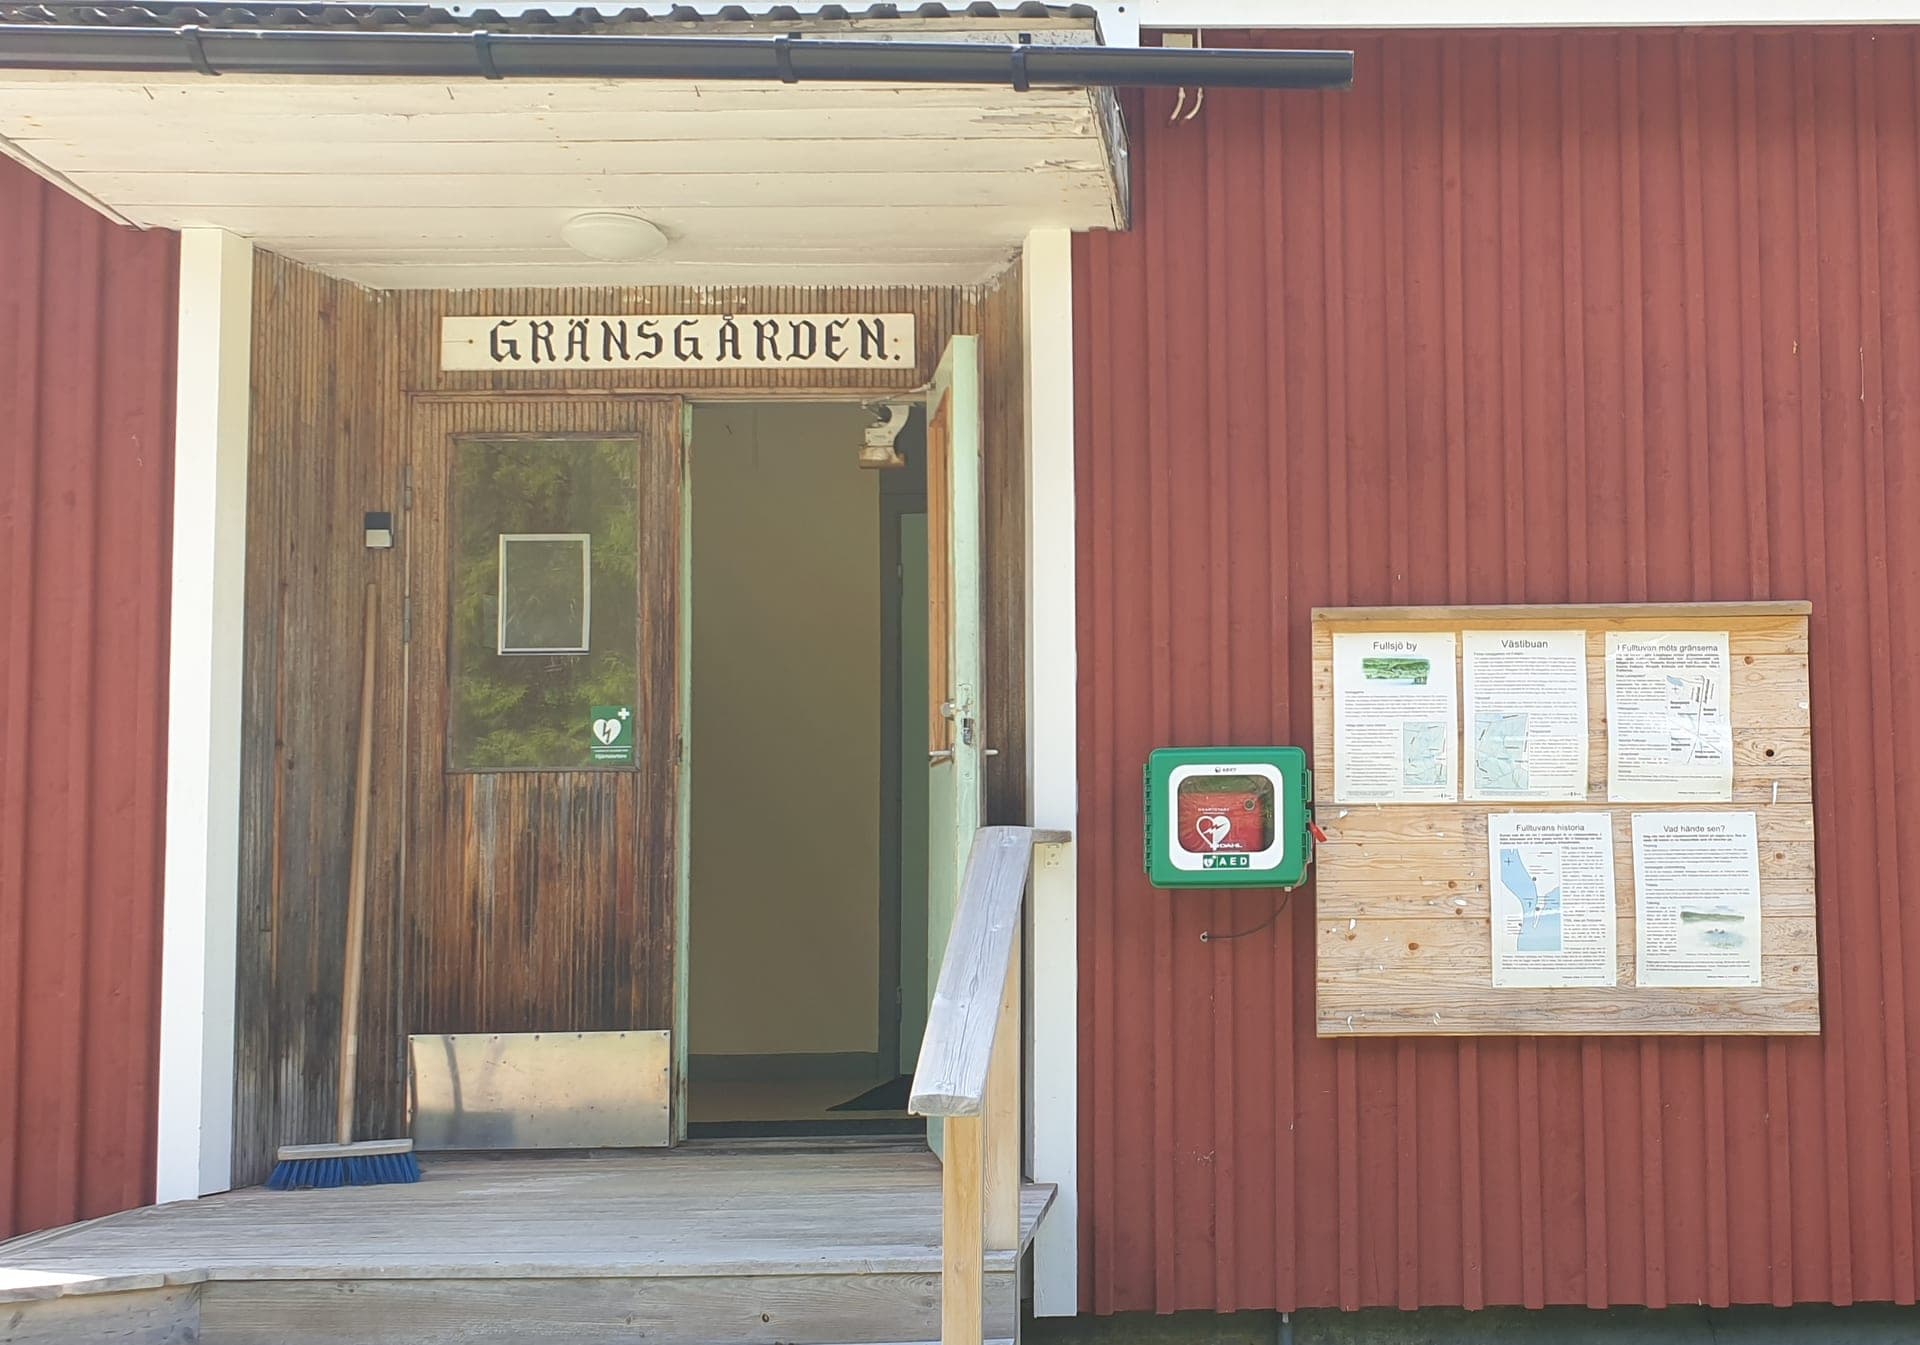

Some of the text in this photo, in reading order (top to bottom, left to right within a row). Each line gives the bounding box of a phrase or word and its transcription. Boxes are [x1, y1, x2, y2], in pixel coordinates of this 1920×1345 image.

[489, 314, 901, 363] GRÄNSGÅRDEN.
[1373, 641, 1418, 652] Fullsjö by
[1501, 639, 1549, 649] Västibuan
[1622, 644, 1657, 652] Fulltuvan
[1659, 644, 1678, 652] möts
[1680, 644, 1718, 653] gränserna
[1516, 824, 1585, 832] Fulltuvans historia
[1663, 825, 1726, 833] Vad hände sen?
[1219, 854, 1248, 866] AED
